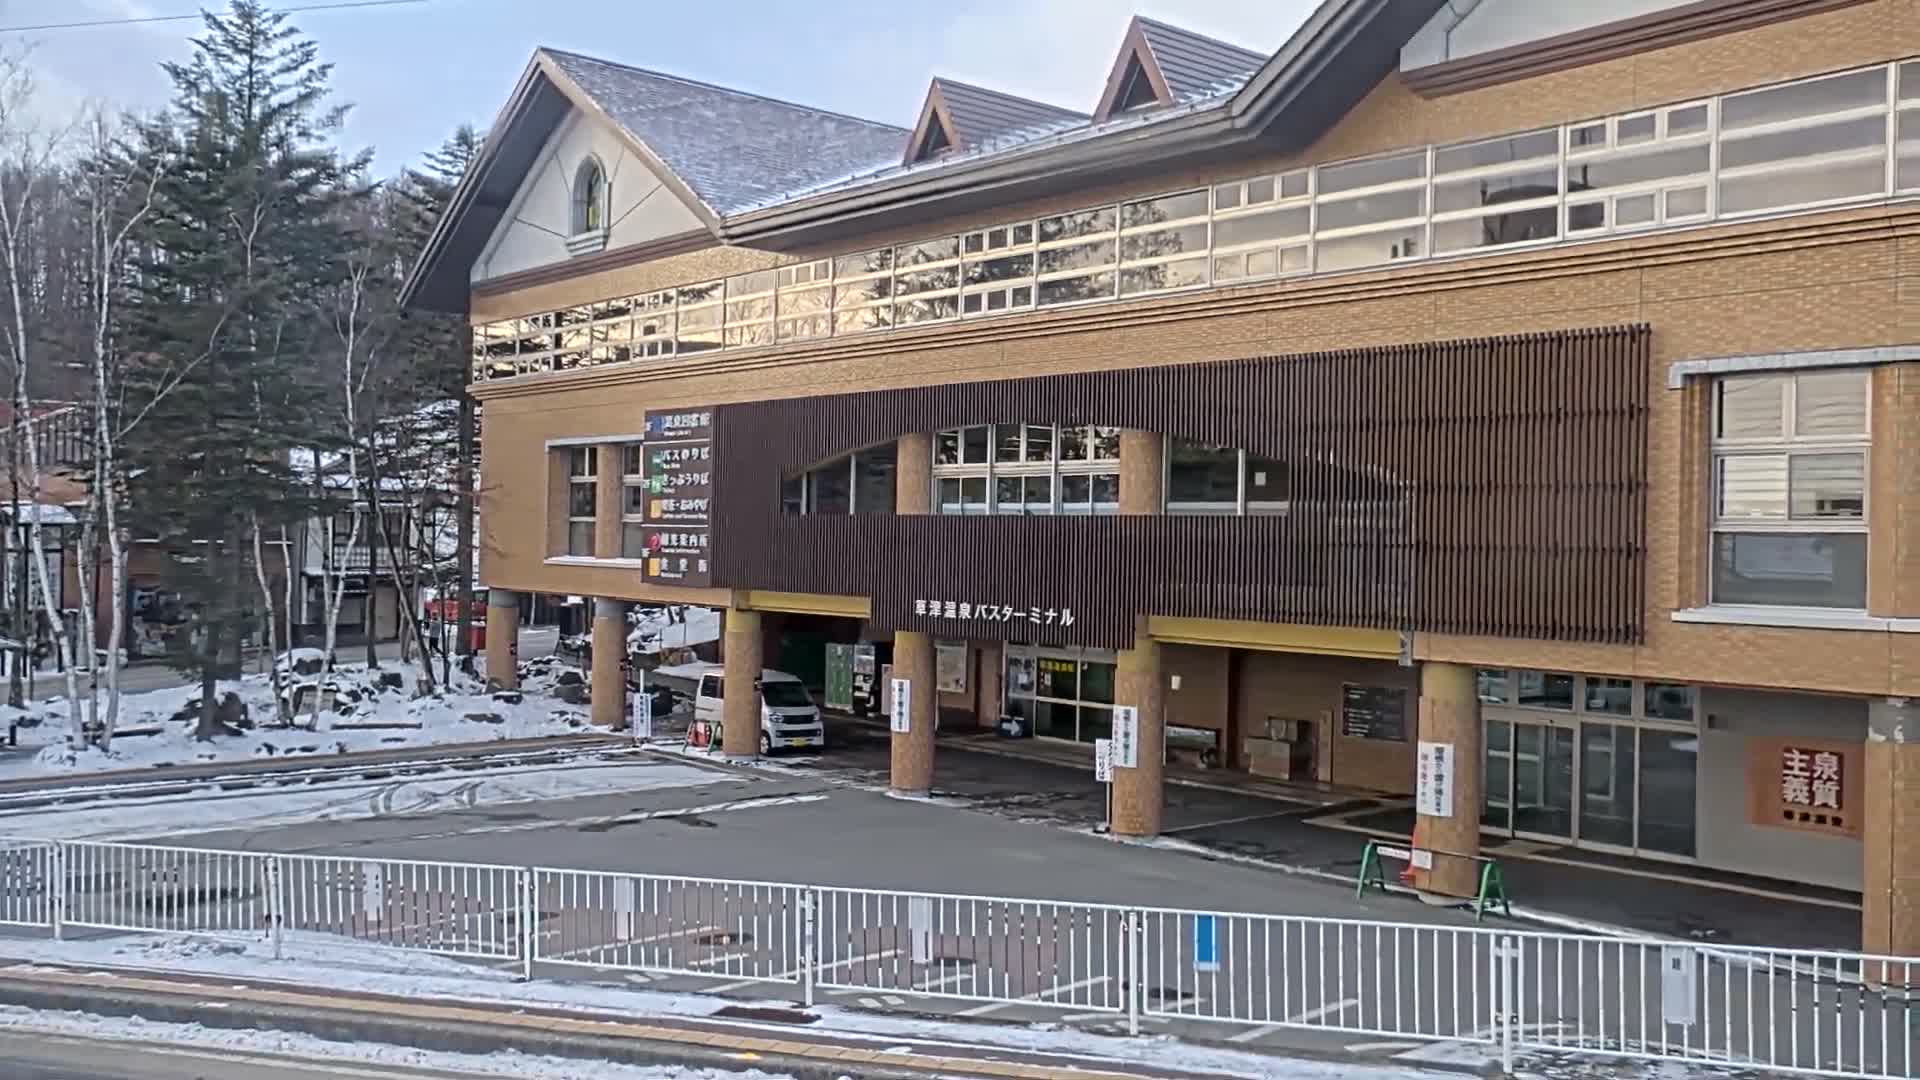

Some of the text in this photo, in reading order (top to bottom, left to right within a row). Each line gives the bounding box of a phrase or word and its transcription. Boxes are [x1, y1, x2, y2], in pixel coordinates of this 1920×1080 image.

[662, 447, 710, 461] バスのりば
[662, 472, 709, 486] きっぷうりば
[915, 599, 1075, 626] 草津温泉バスターミナル
